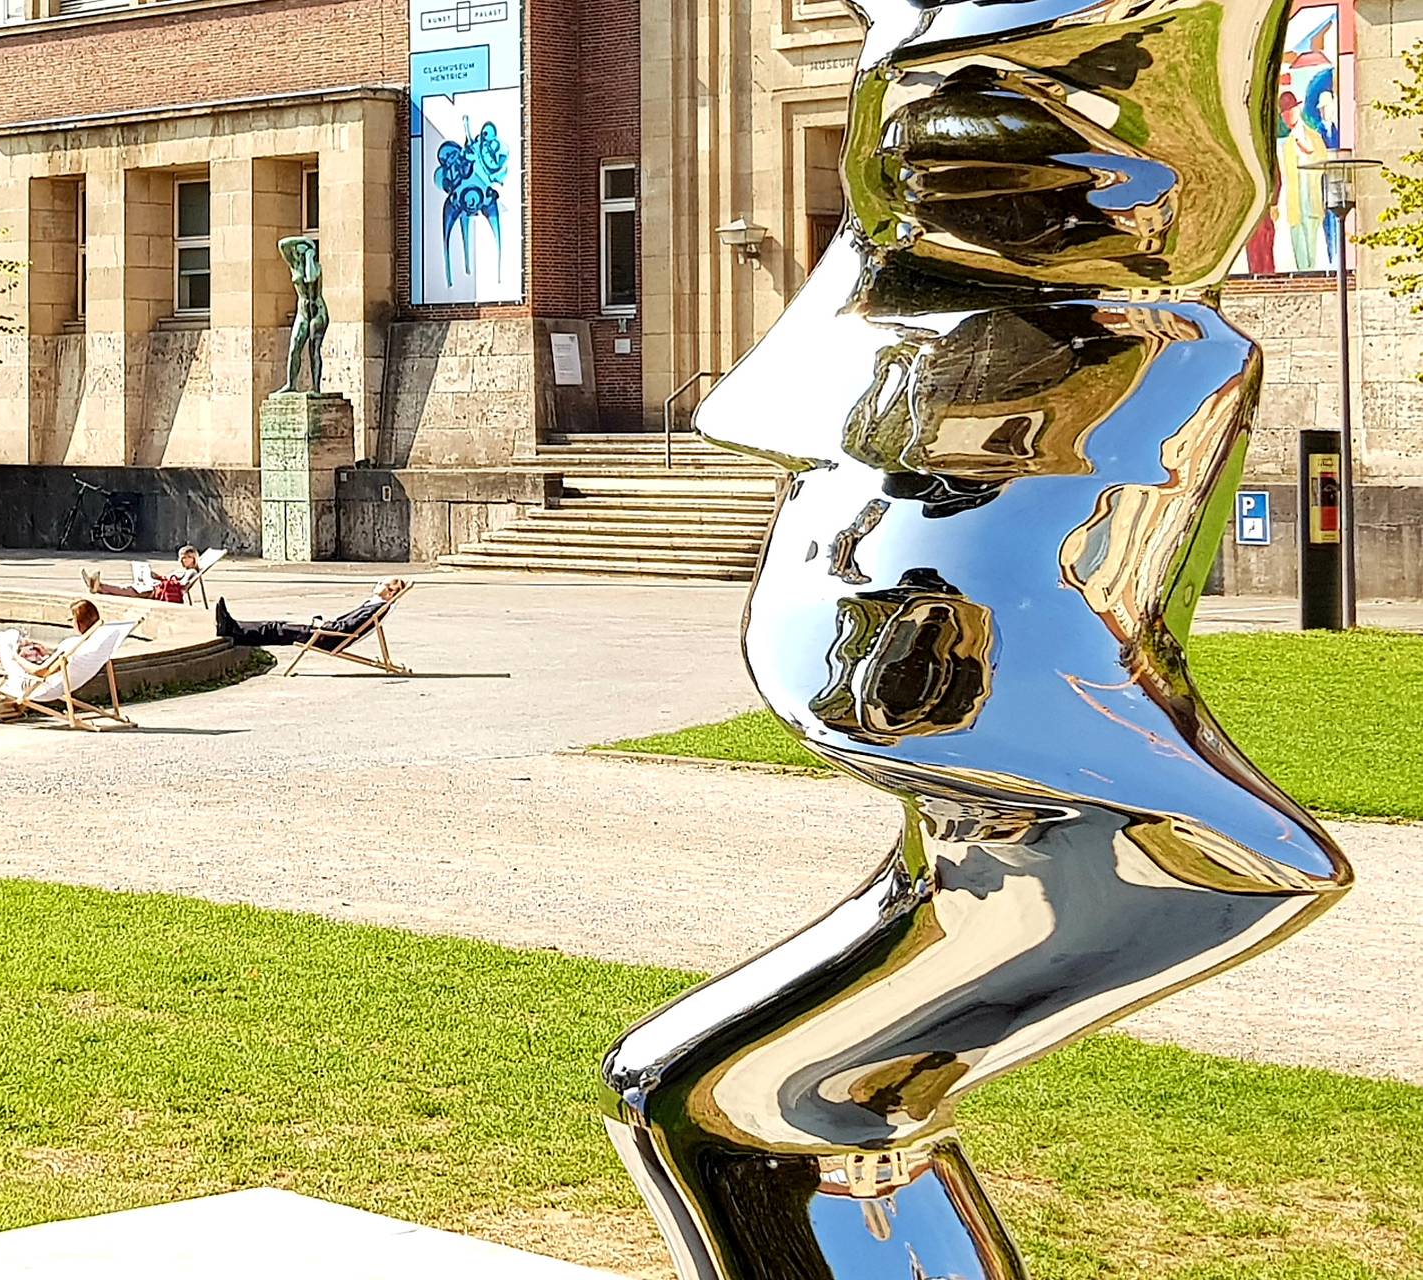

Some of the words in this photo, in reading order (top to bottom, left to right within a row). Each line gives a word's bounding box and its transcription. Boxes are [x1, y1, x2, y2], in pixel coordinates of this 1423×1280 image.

[428, 15, 451, 24] KUNST
[474, 8, 502, 18] PALAST
[810, 57, 855, 71] MUSEUM
[430, 71, 468, 82] HENTRICH
[1242, 496, 1255, 516] P
